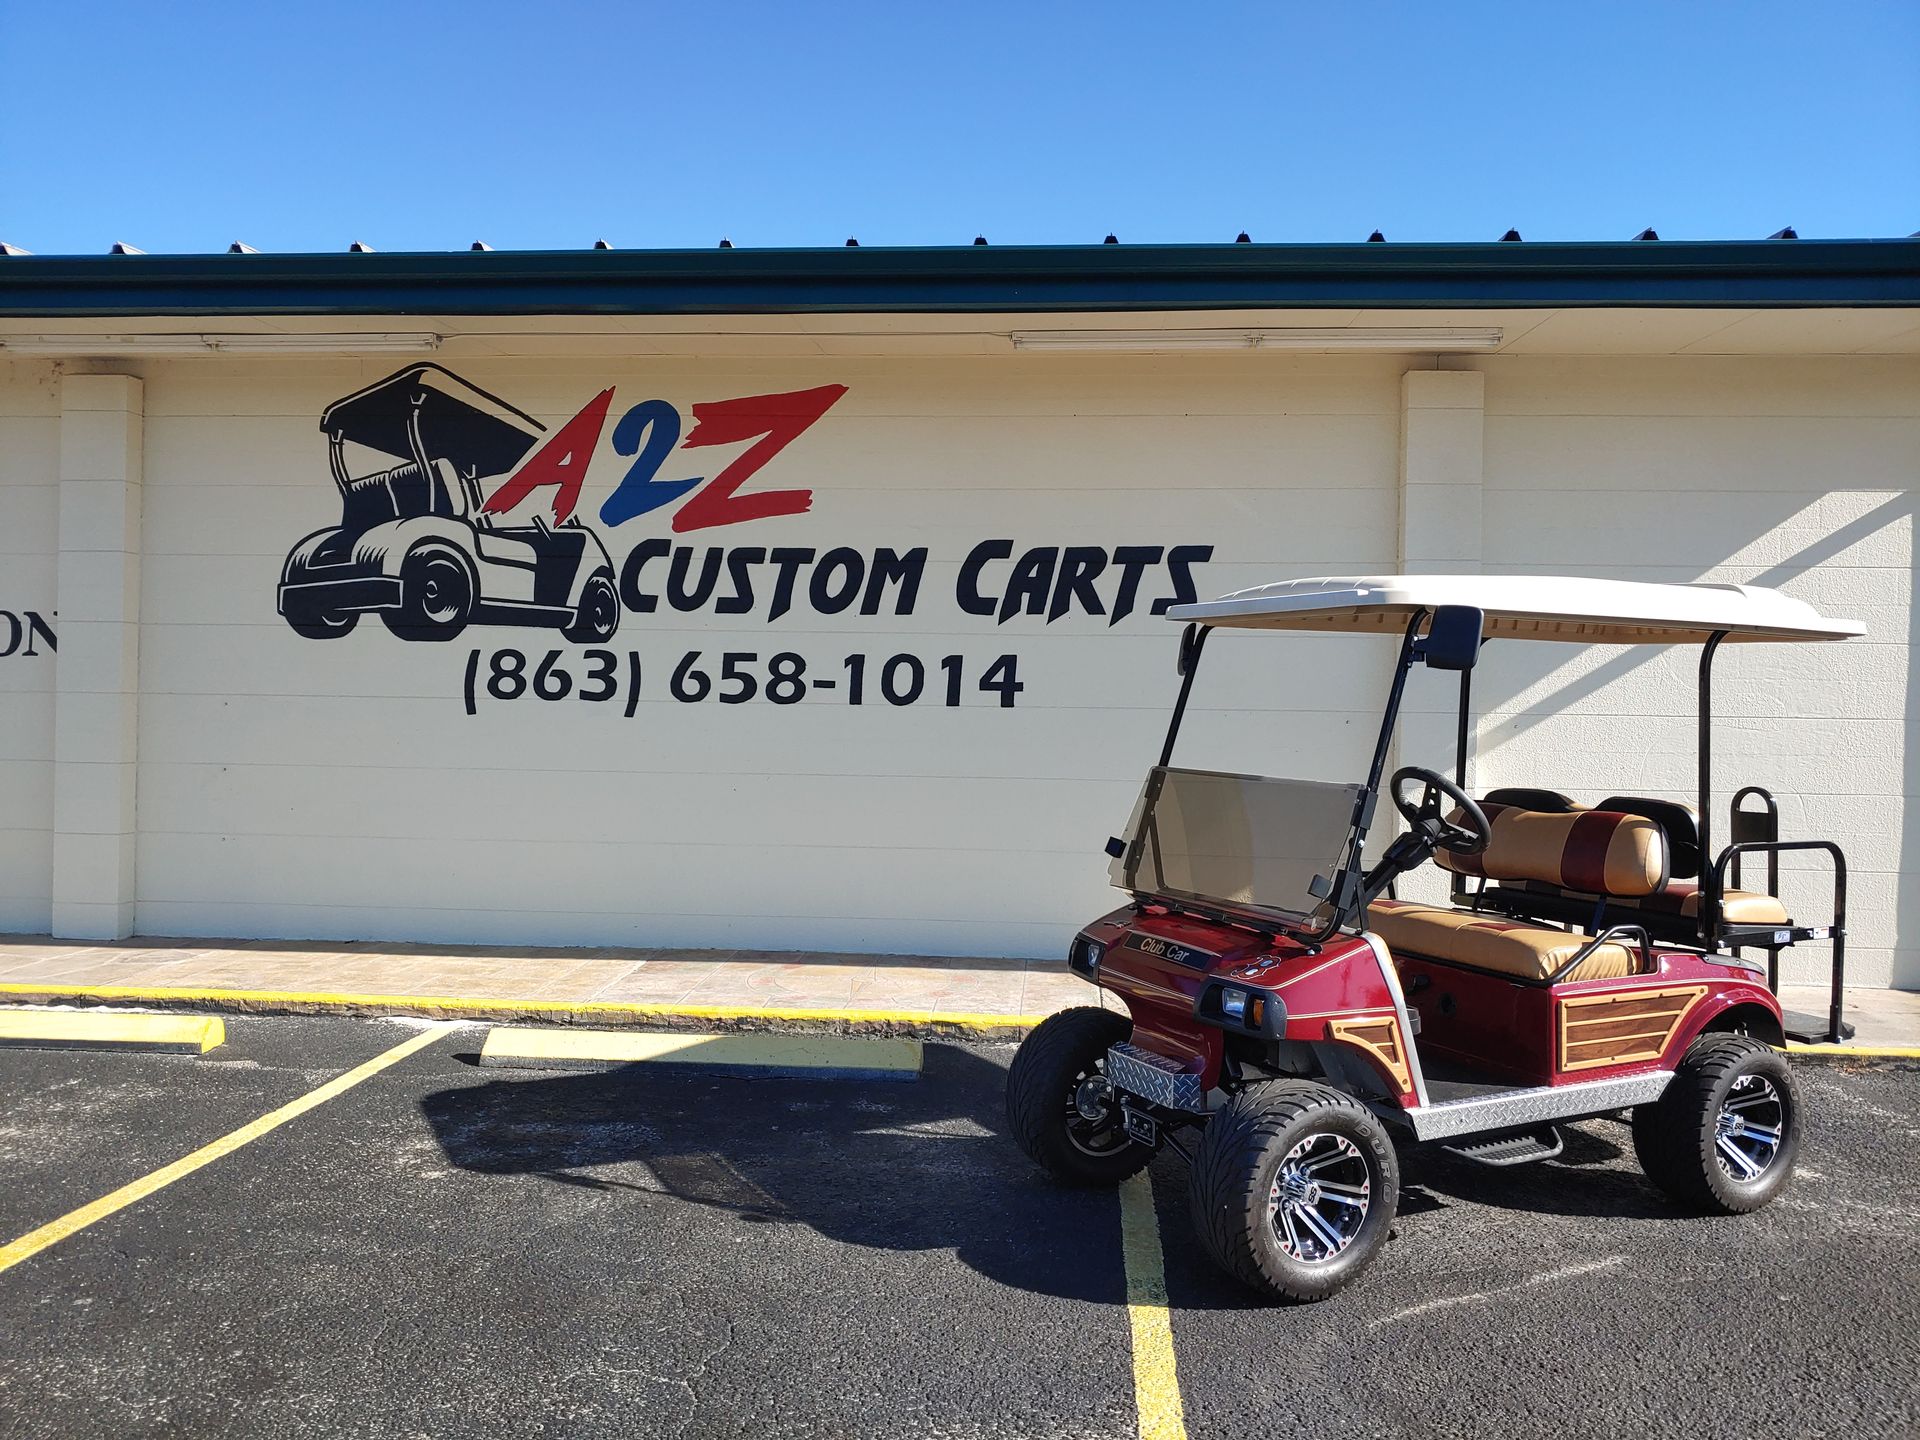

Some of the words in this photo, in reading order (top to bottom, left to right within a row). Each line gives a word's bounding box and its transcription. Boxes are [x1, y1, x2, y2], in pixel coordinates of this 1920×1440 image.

[480, 384, 849, 533] A2Z
[620, 539, 928, 624] CUSTOM
[956, 540, 1214, 627] CARTS
[463, 649, 642, 718] (863)
[669, 651, 1024, 709] 658-1014
[1140, 938, 1165, 955] Club
[1167, 945, 1190, 962] Car
[1354, 1123, 1393, 1204] DURO
